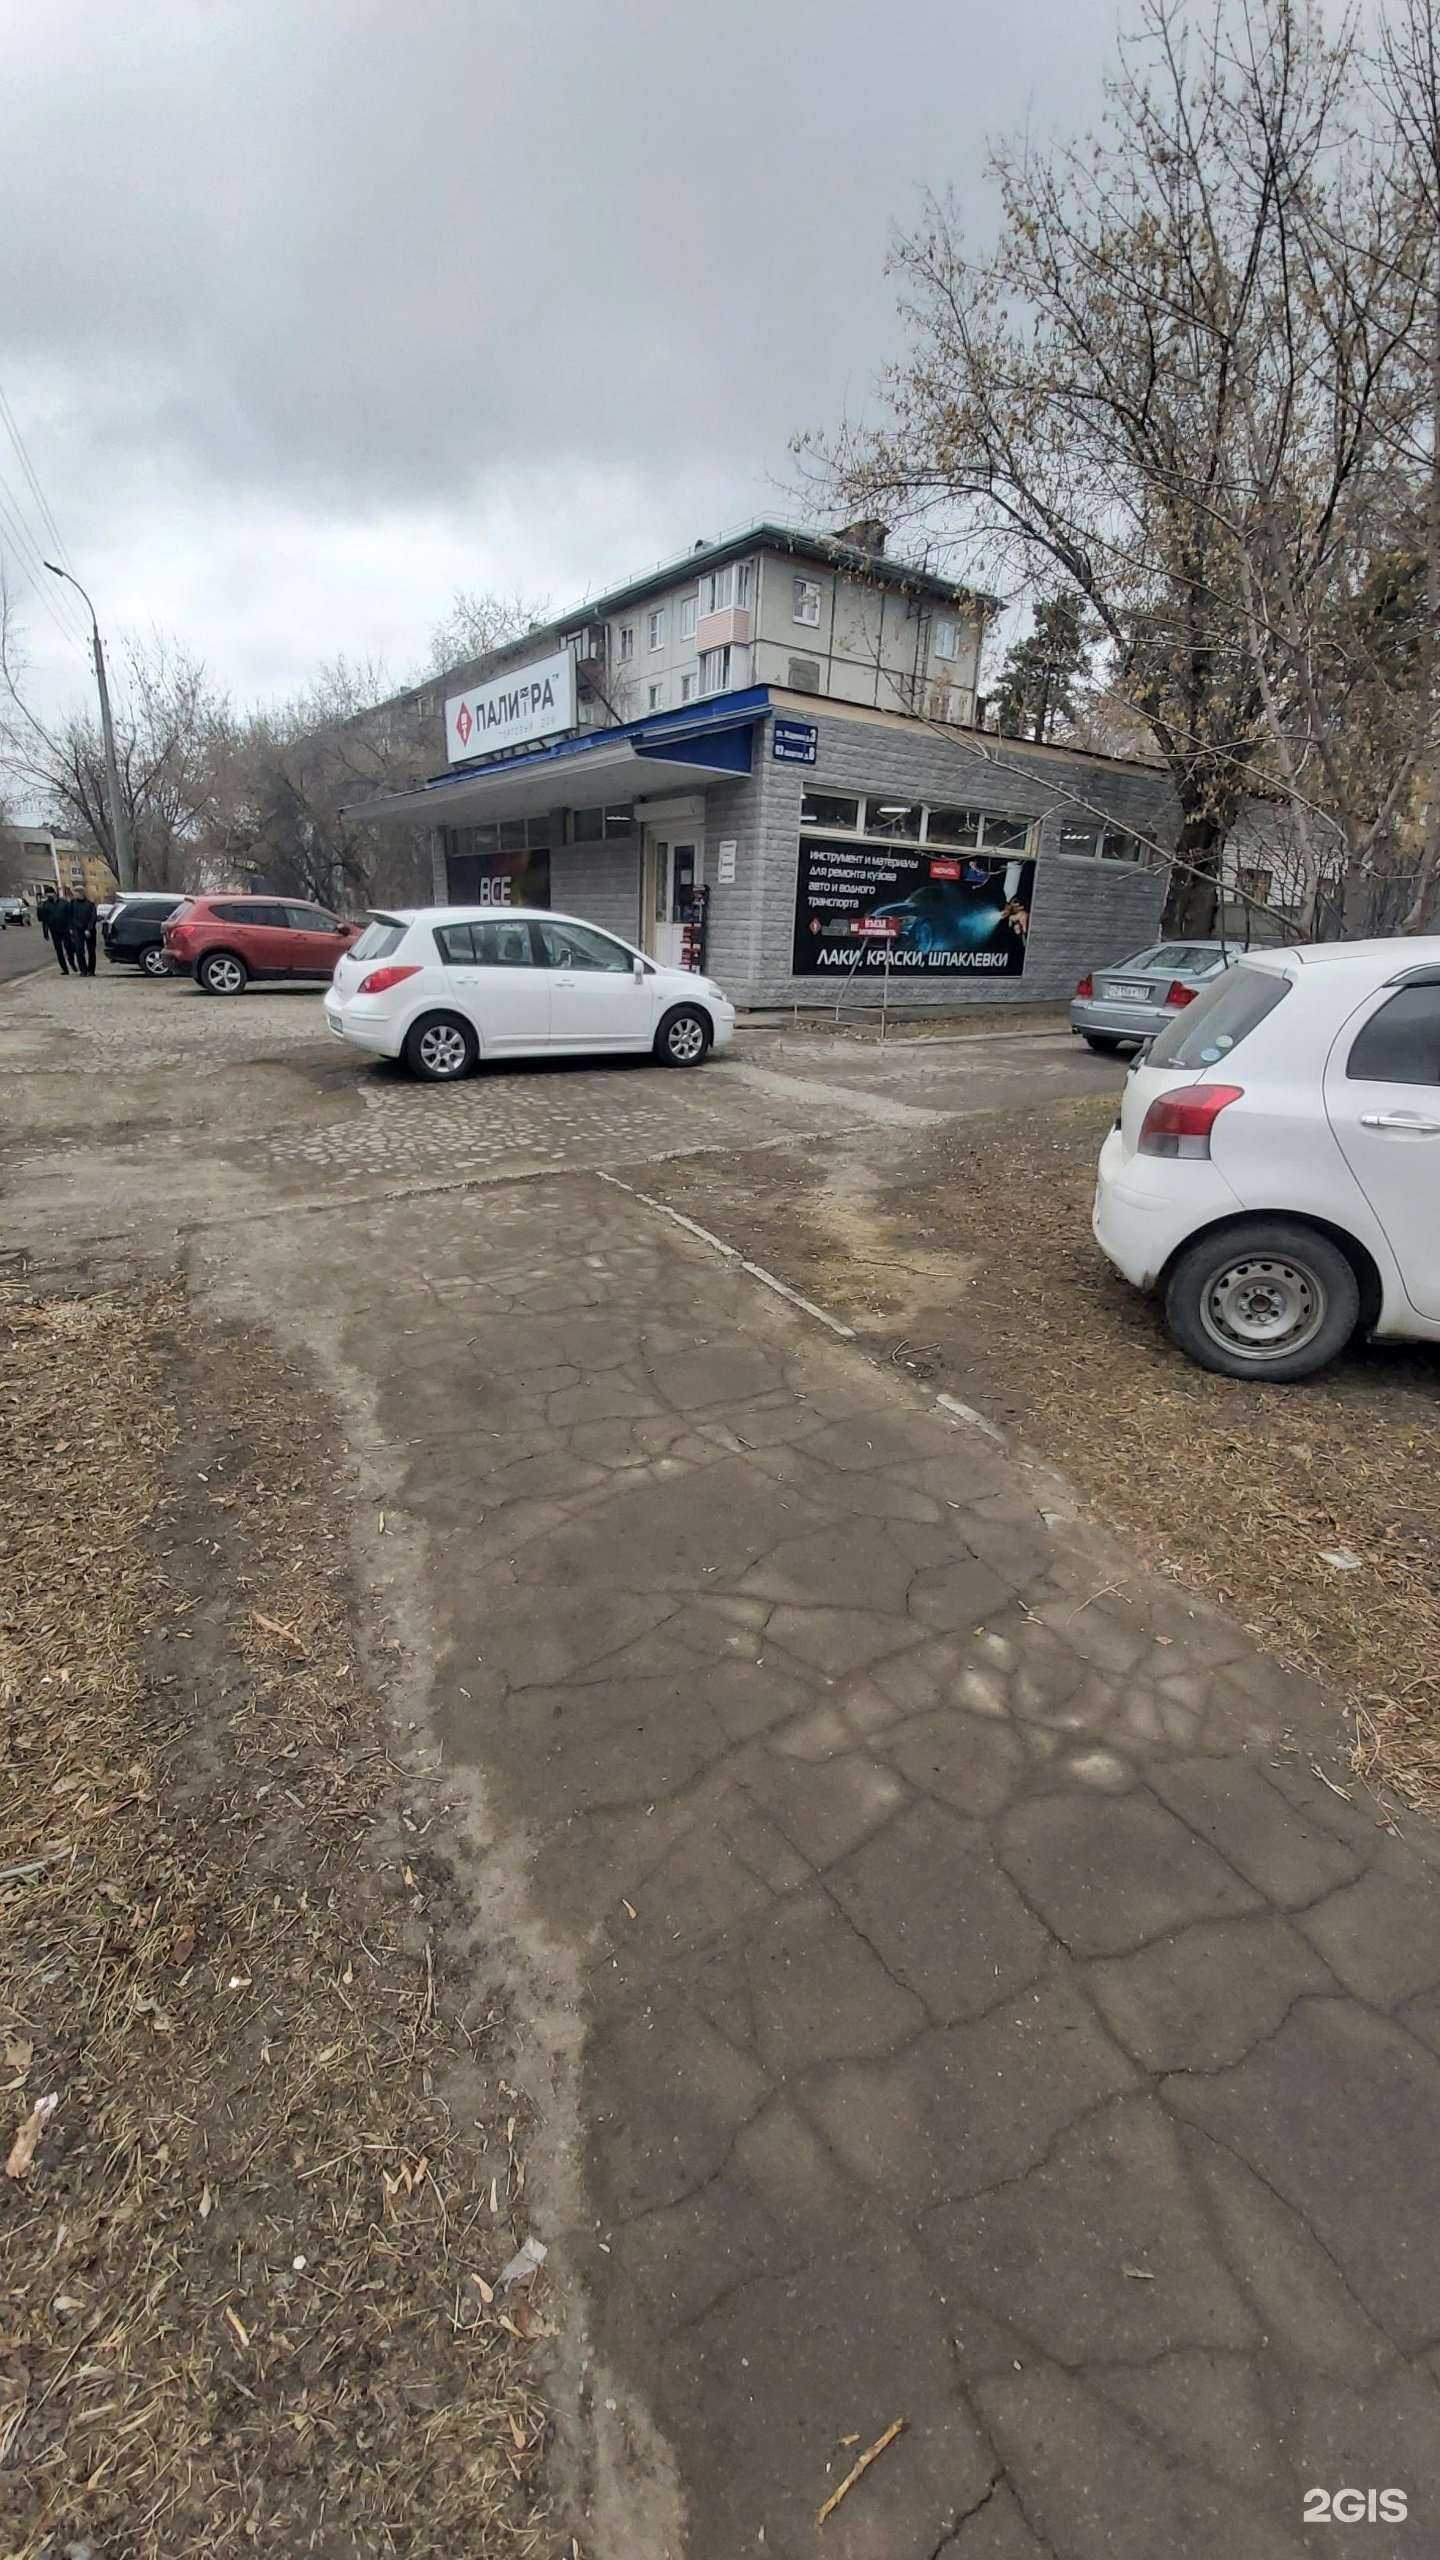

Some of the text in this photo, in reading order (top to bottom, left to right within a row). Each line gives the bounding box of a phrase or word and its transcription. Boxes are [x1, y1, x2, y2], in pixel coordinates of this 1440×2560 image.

[872, 857, 919, 869] материалы
[809, 865, 897, 882] для ремонта кузова
[480, 876, 512, 906] ВСЕ
[808, 881, 830, 891] авто
[839, 884, 876, 895] водного
[808, 896, 859, 909] транспорта
[816, 948, 1009, 968] ЛАКИ, КРАСКИ, ШПАКЛЕВКИ
